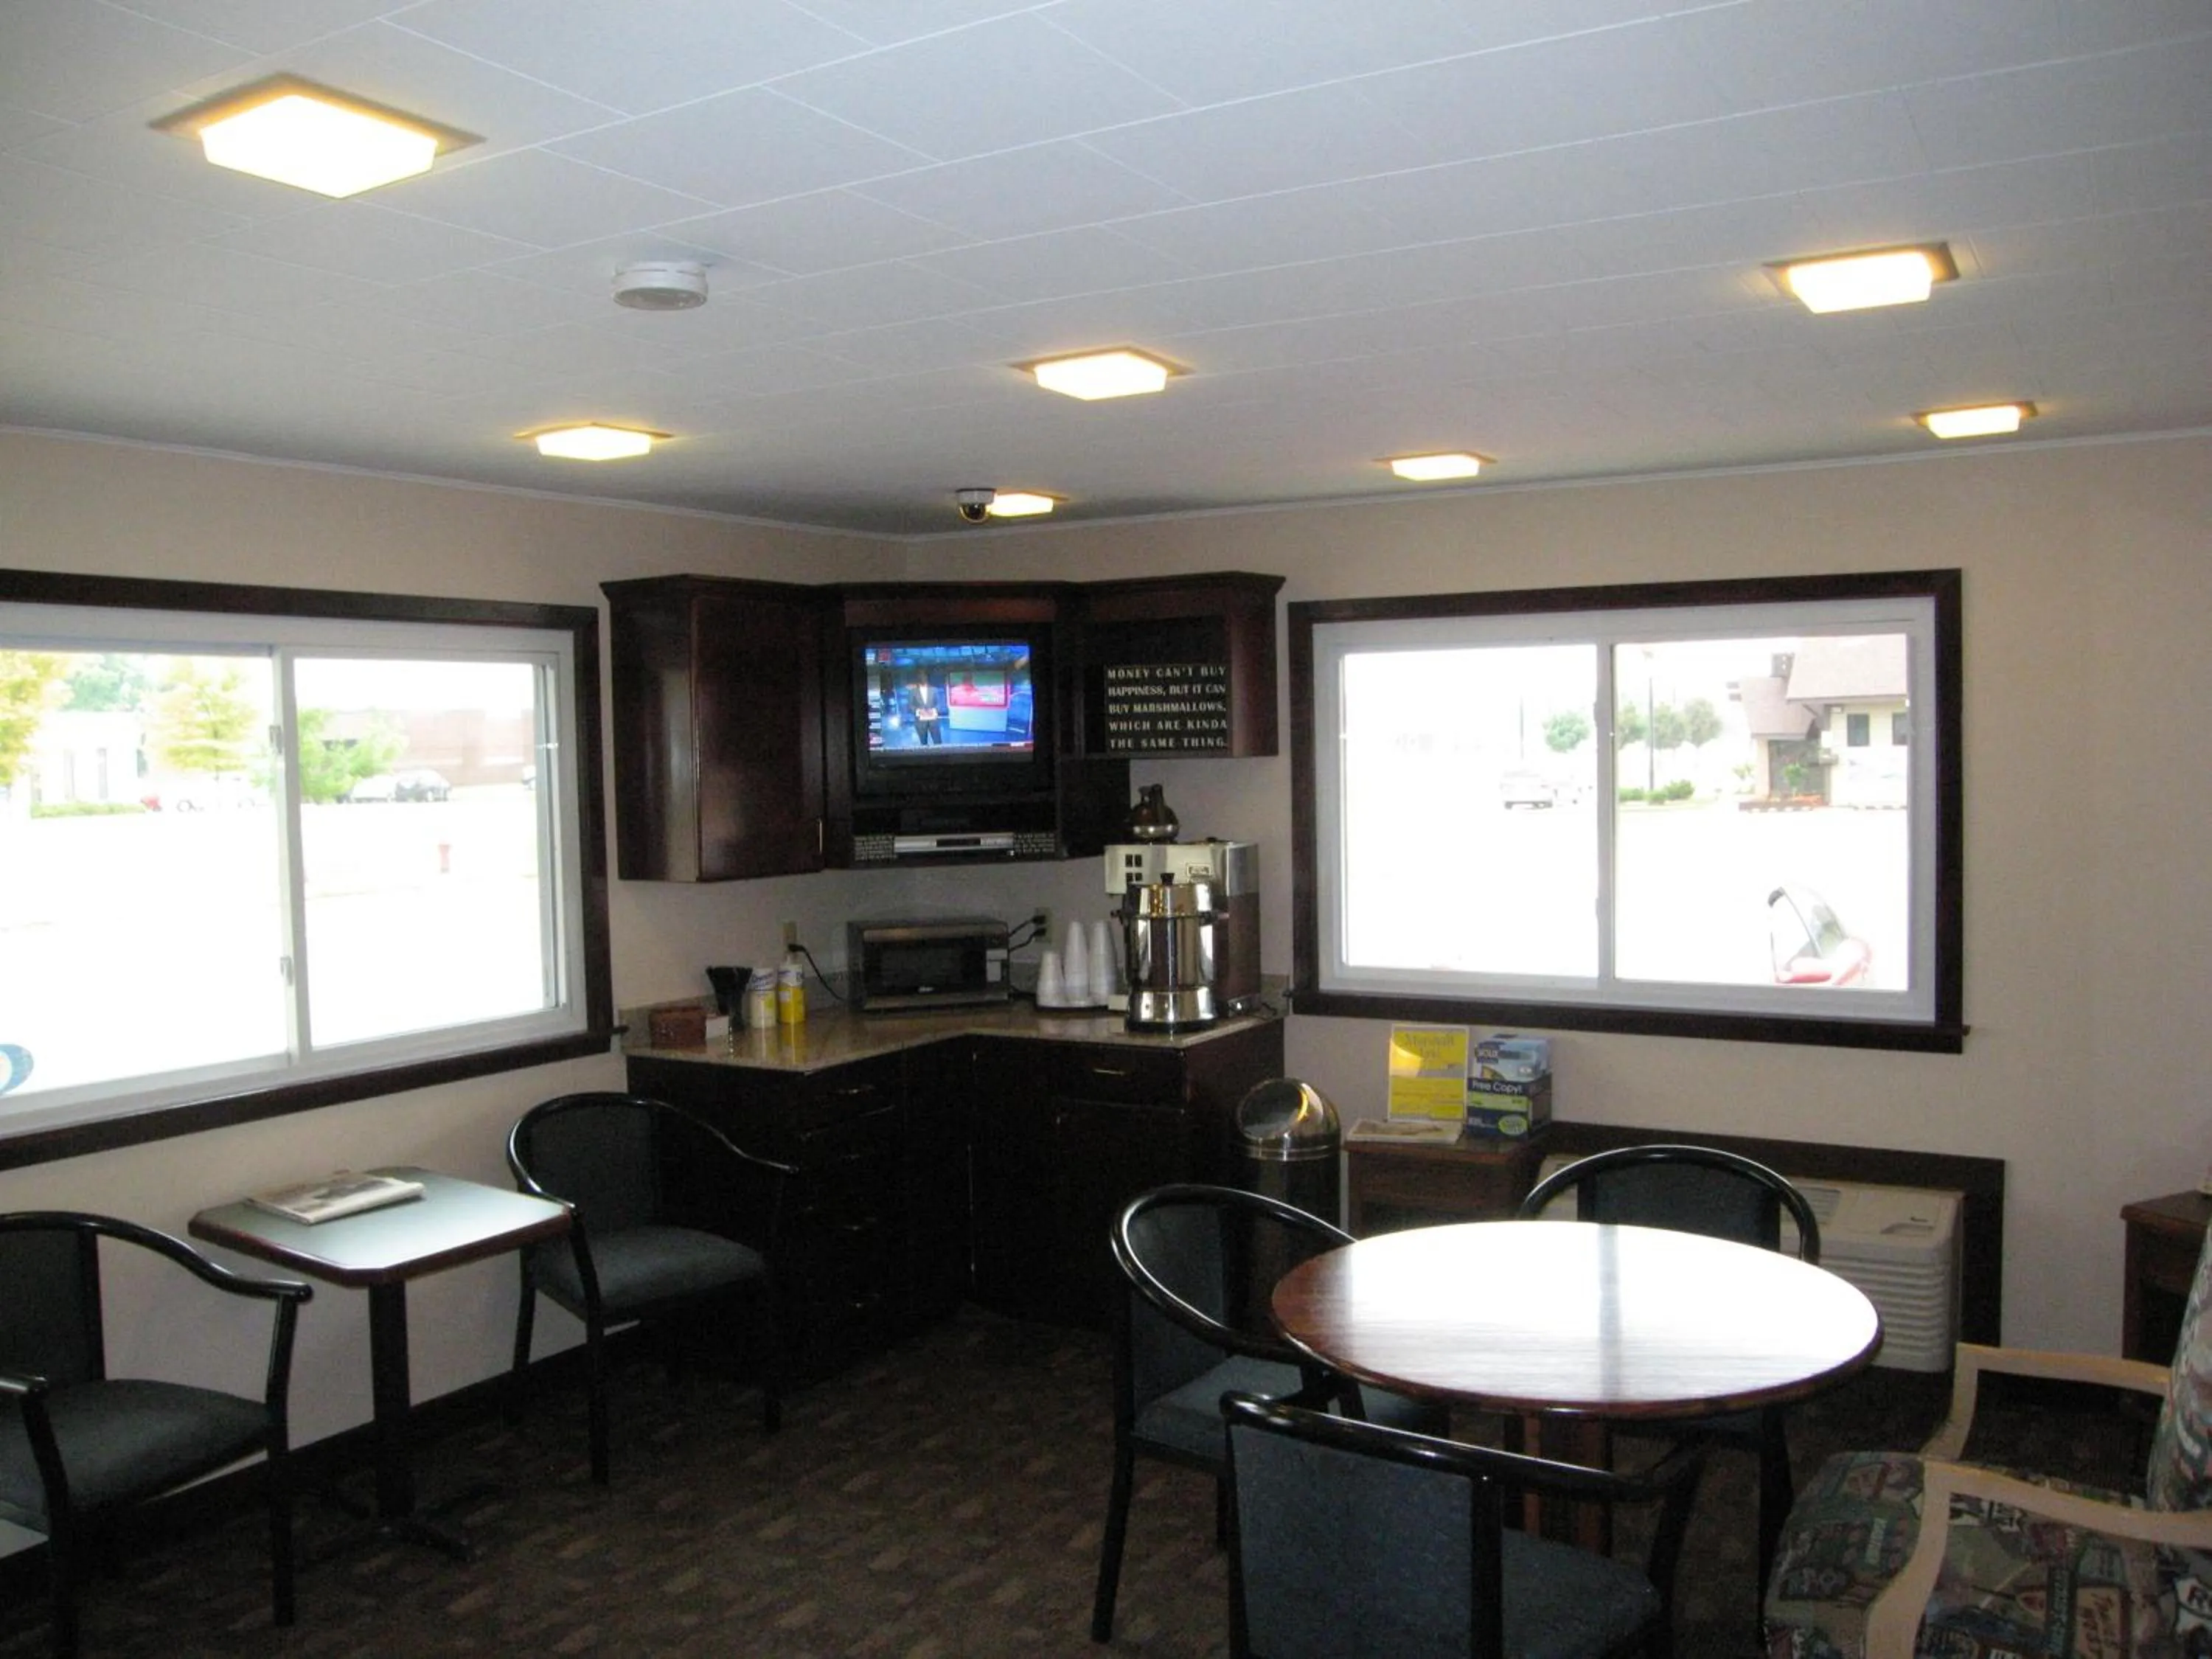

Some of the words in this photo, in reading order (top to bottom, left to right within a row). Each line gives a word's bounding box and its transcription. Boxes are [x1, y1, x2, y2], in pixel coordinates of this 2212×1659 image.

[1107, 669, 1150, 678] MONEY
[1156, 667, 1193, 678] CAN'T
[1200, 667, 1225, 676] BUY
[1108, 686, 1166, 696] HAPPINESS,
[1169, 684, 1189, 695] BUT
[1192, 684, 1202, 694] IT
[1206, 684, 1226, 693] CAN
[1108, 703, 1130, 714] BUY
[1110, 721, 1150, 731] WHICH
[1157, 720, 1181, 730] ARE
[1187, 720, 1227, 729] KINDA
[1110, 739, 1133, 748] THE
[1141, 738, 1174, 748] SAME
[1472, 1080, 1491, 1091] Free
